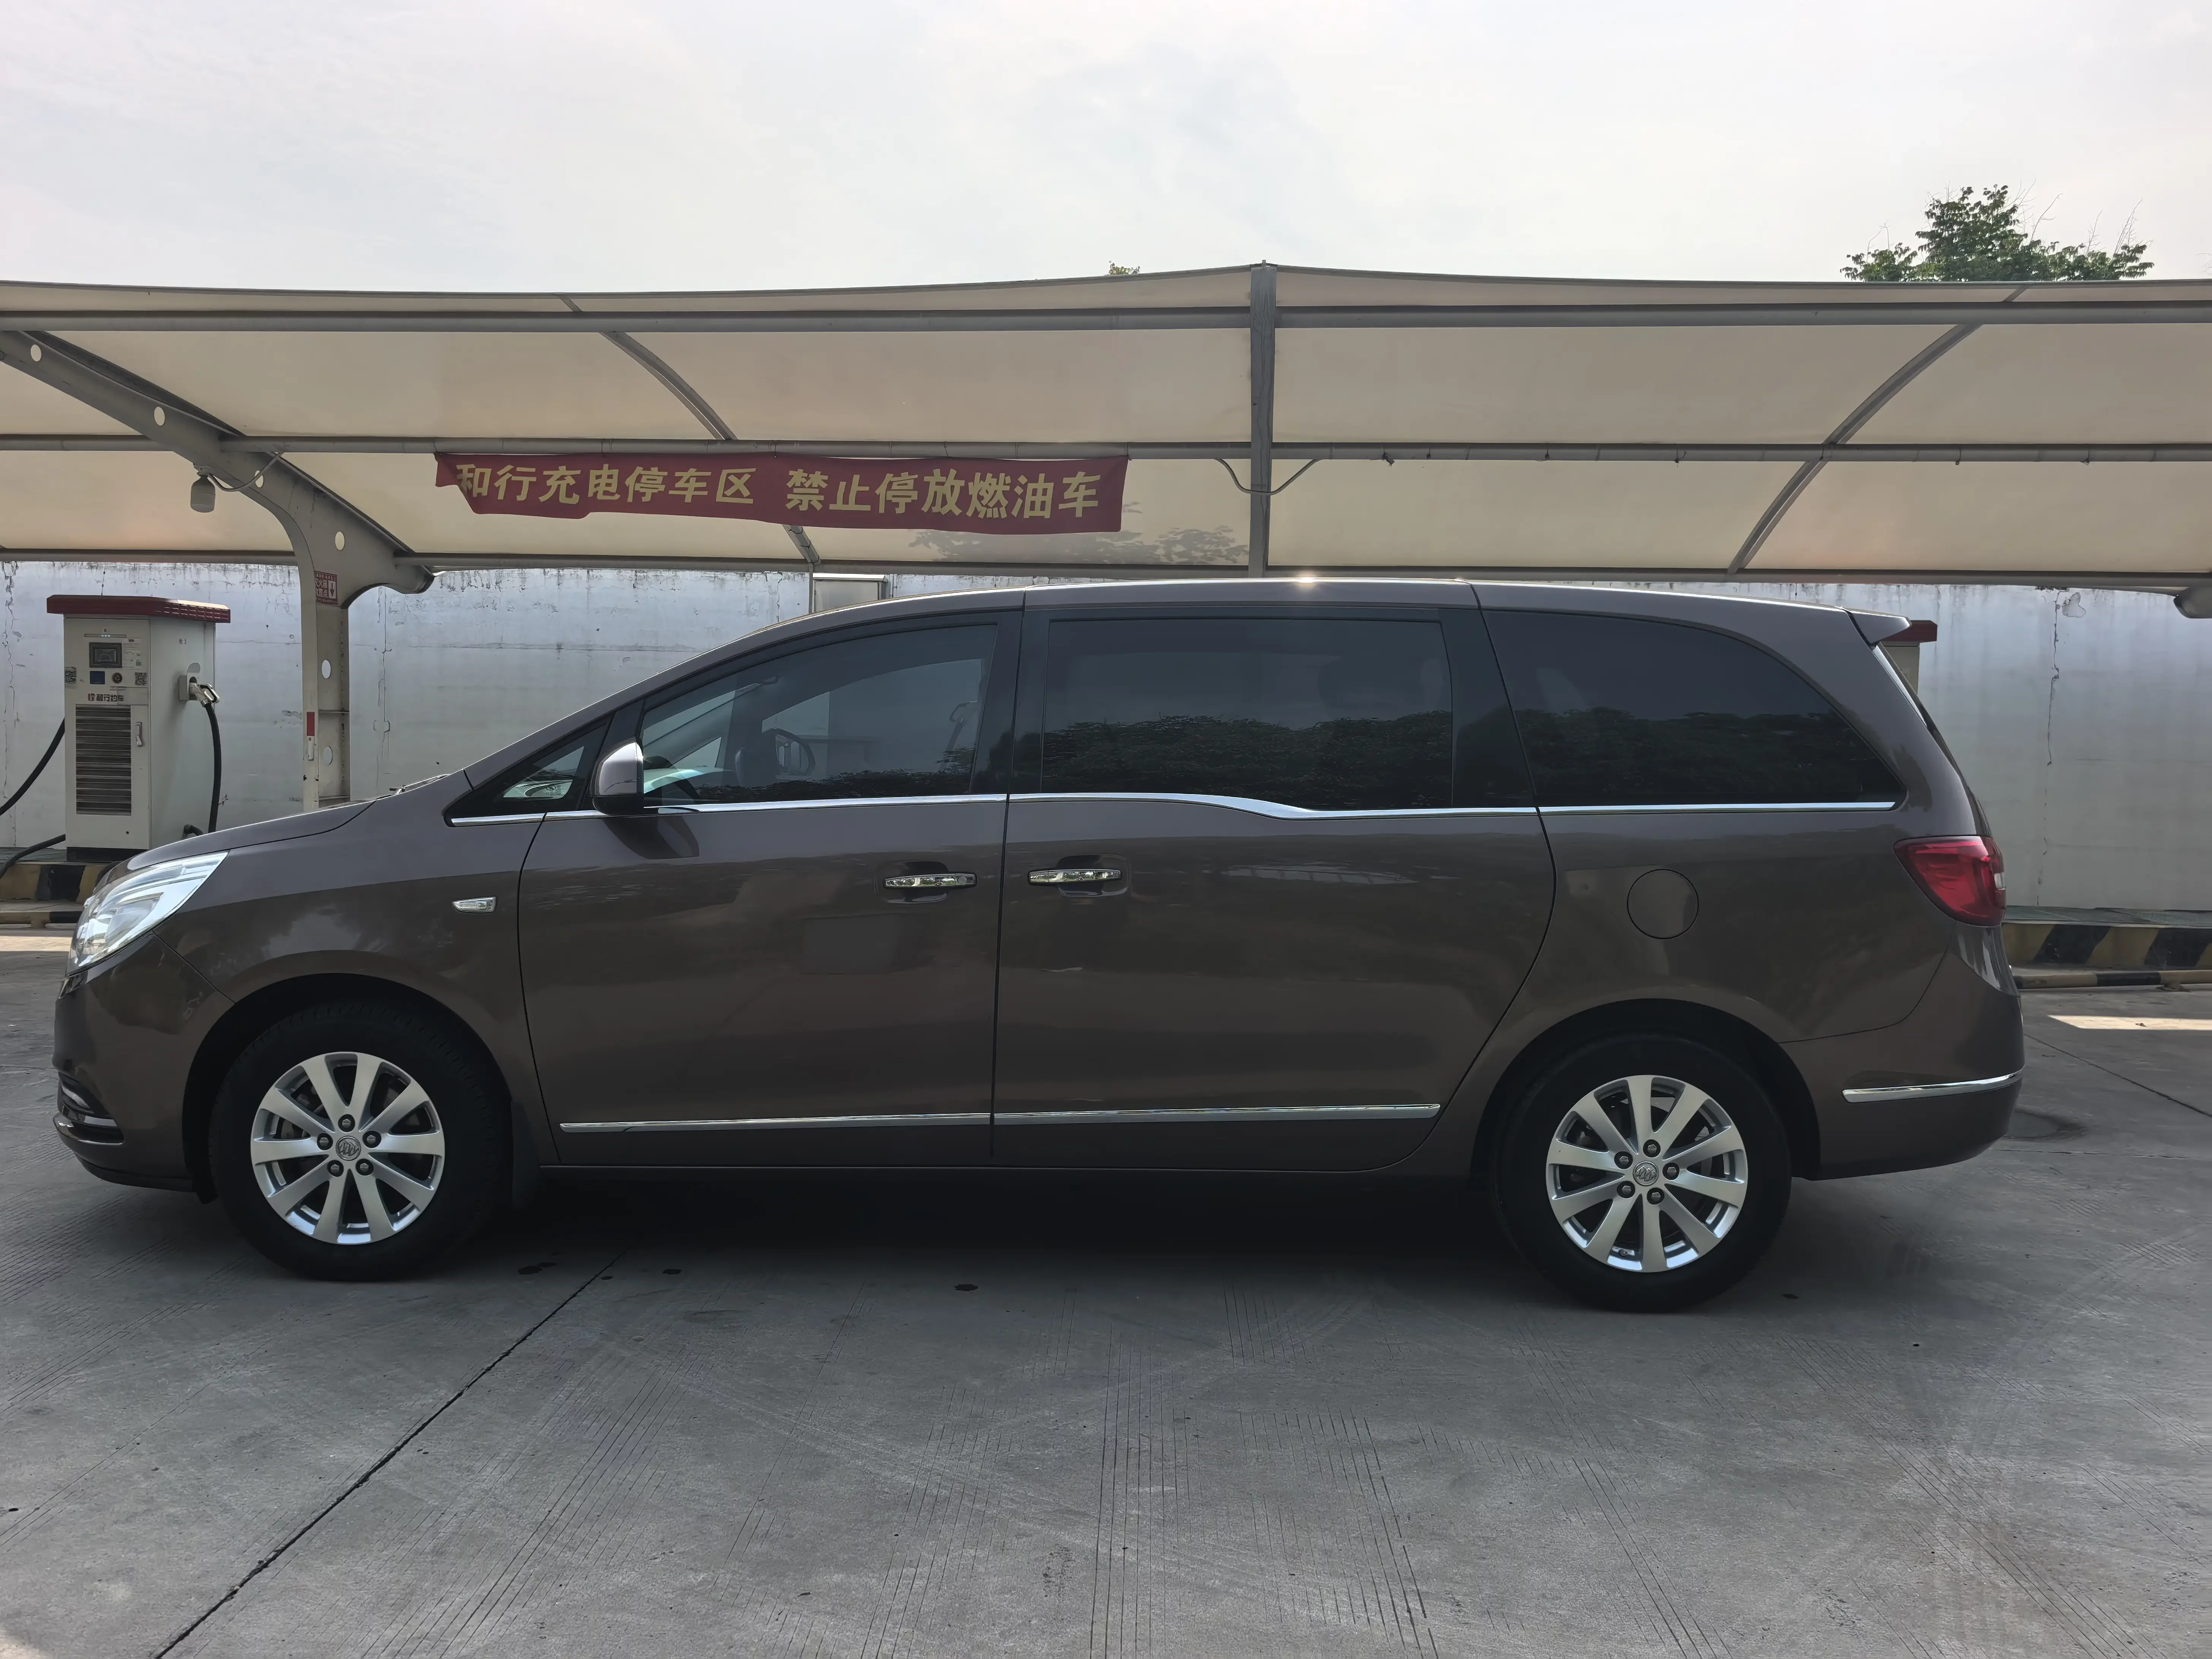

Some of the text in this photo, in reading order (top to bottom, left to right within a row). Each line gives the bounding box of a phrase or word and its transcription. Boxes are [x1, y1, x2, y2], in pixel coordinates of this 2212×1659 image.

[456, 464, 1101, 519] 和行充电停车区 禁止停放燃油车
